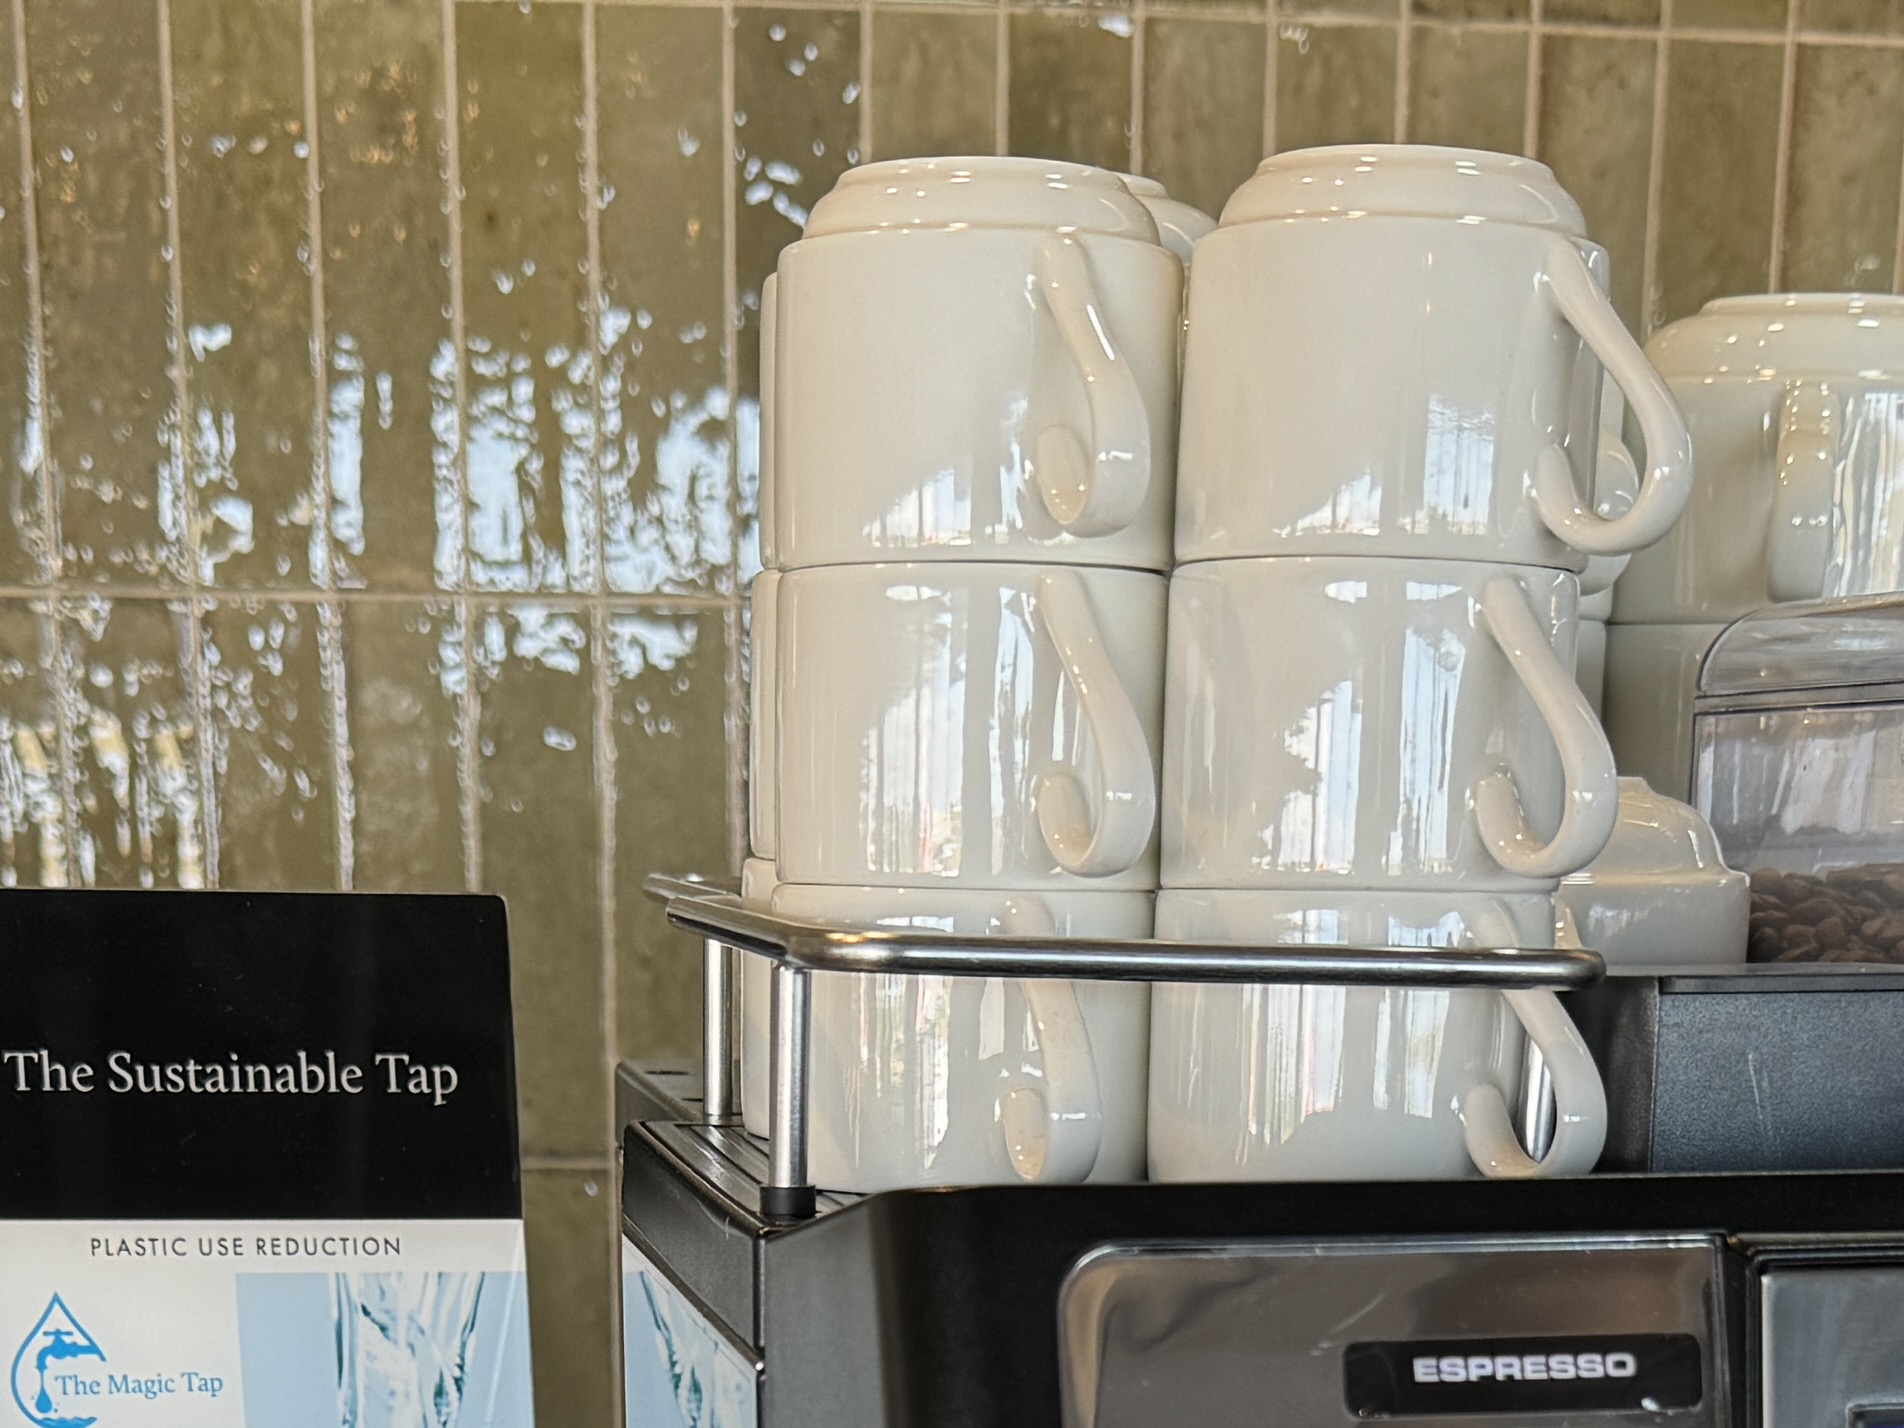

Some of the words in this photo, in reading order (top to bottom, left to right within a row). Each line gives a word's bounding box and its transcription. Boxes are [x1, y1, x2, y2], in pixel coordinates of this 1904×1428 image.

[3, 1048, 94, 1093] The
[107, 1049, 364, 1095] Sustainable
[374, 1053, 459, 1106] Tap
[90, 1237, 188, 1258] PLASTIC
[198, 1237, 245, 1257] USE
[256, 1236, 402, 1257] REDUCTION
[1412, 1352, 1638, 1384] ESPRESSO
[54, 1374, 101, 1396] The
[108, 1372, 176, 1400] Magic
[180, 1371, 223, 1397] Tap
